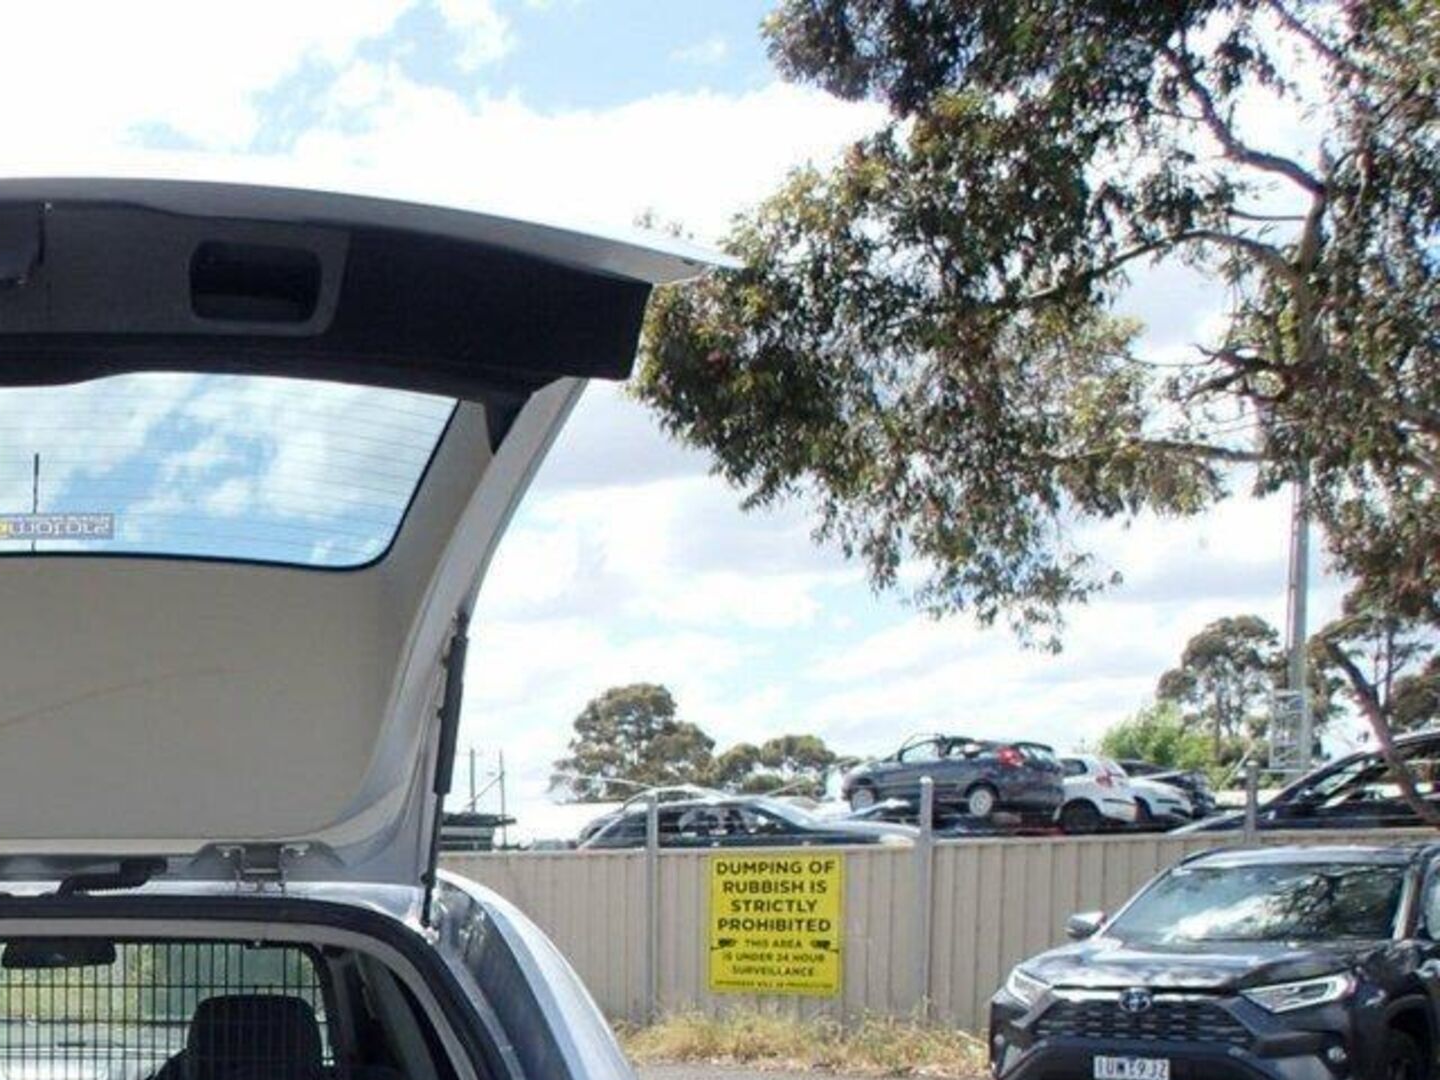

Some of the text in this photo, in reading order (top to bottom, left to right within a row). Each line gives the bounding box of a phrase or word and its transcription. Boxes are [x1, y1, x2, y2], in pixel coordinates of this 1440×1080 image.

[716, 860, 835, 875] DUMPING OF
[722, 880, 827, 894] RUBBISH IS
[730, 899, 817, 913] STRICTLY
[717, 918, 831, 932] PROHIBITED
[744, 939, 802, 949] THIS AREA
[722, 952, 825, 963] IS UNDER 24 HOUR
[732, 965, 814, 977] SURVEILLANCE
